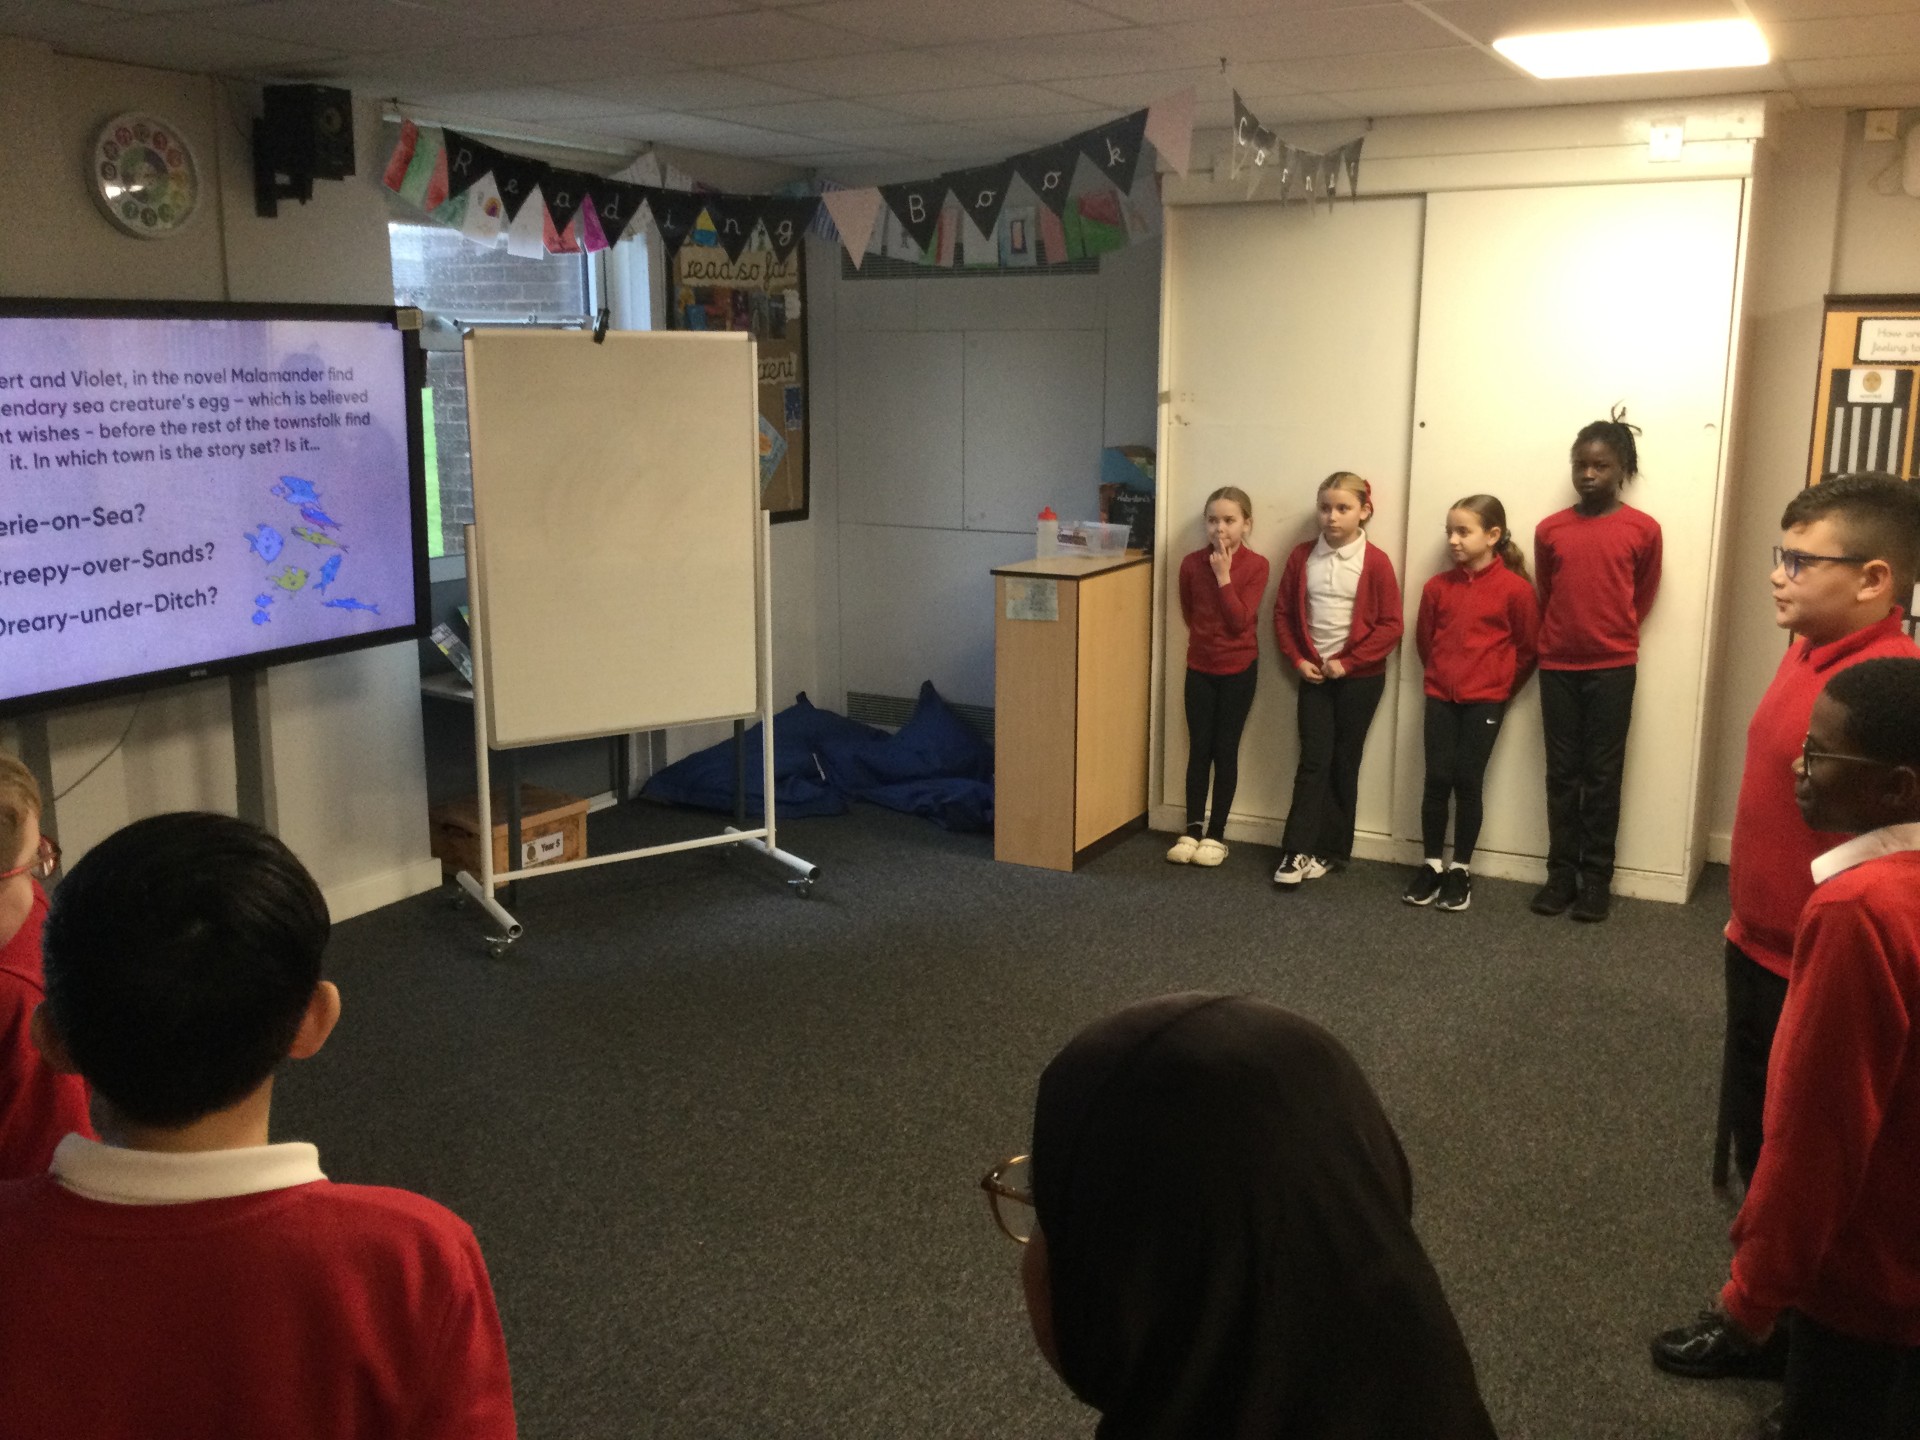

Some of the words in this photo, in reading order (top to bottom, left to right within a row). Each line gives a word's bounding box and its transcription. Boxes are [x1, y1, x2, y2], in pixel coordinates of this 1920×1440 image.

[452, 146, 793, 246] Reading
[907, 138, 1126, 224] Book
[30, 371, 65, 389] and
[70, 370, 128, 389] Violet,
[132, 370, 148, 386] in
[152, 370, 179, 385] the
[184, 368, 227, 384] novel
[231, 367, 324, 383] Malamander
[328, 366, 354, 381] find
[758, 355, 794, 380] rent
[1, 399, 67, 419] endary
[73, 401, 104, 414] sea
[109, 394, 195, 412] creature's
[199, 397, 229, 412] egg
[248, 391, 291, 407] which
[295, 390, 306, 405] is
[310, 389, 368, 405] believed
[18, 425, 80, 443] wishes
[99, 421, 155, 439] before
[160, 420, 187, 436] the
[192, 418, 221, 433] rest
[226, 417, 241, 433] of
[246, 416, 270, 431] the
[274, 412, 341, 430] townsfolk
[345, 411, 371, 426] find
[10, 454, 28, 470] it.
[34, 453, 50, 469] In
[56, 449, 107, 468] which
[112, 449, 155, 464] town
[160, 444, 172, 460] is
[176, 443, 202, 459] the
[208, 442, 245, 459] story
[250, 438, 280, 455] set?
[285, 438, 297, 452] Is
[300, 437, 320, 451] it...
[0, 541, 215, 586] reepy-over-Sands?
